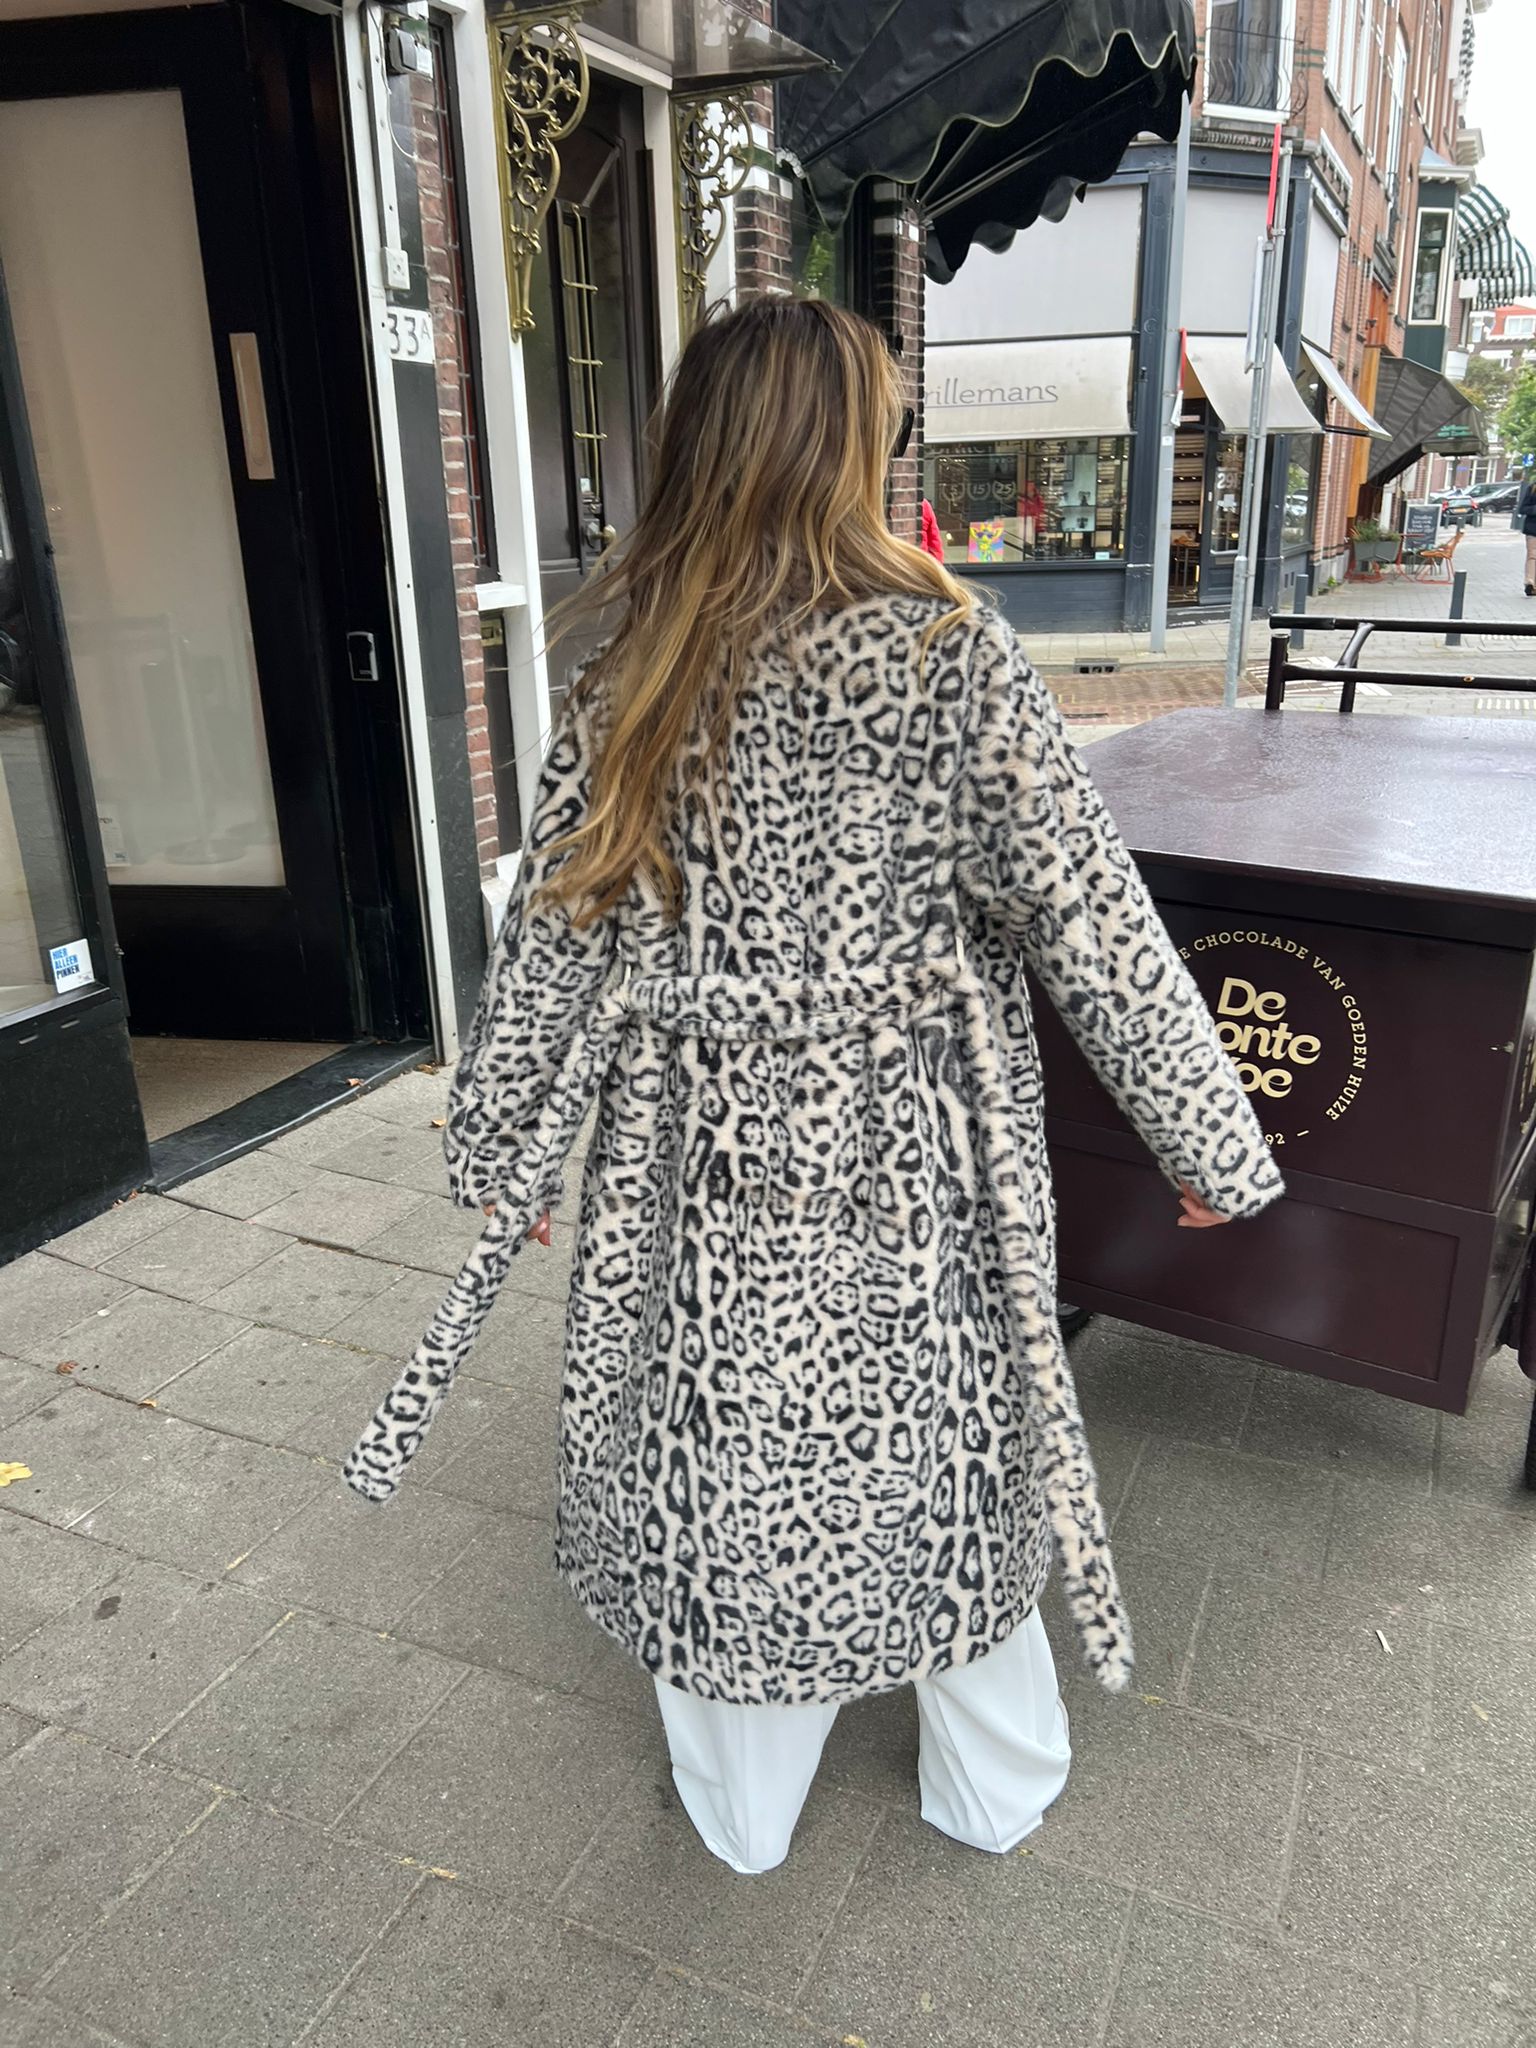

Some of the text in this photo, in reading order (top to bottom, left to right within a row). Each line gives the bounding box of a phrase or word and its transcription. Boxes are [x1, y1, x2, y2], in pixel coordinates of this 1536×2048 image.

[924, 377, 1059, 405] rillemans
[1193, 930, 1309, 960] CHOCOLADE
[1311, 955, 1346, 991] VAN
[1216, 976, 1287, 1021] De
[1213, 1022, 1322, 1065] onte
[1341, 994, 1367, 1070] GOEDEN
[1232, 1057, 1293, 1099] oe
[1325, 1074, 1363, 1121] HUIZE
[1264, 1133, 1286, 1146] 92
